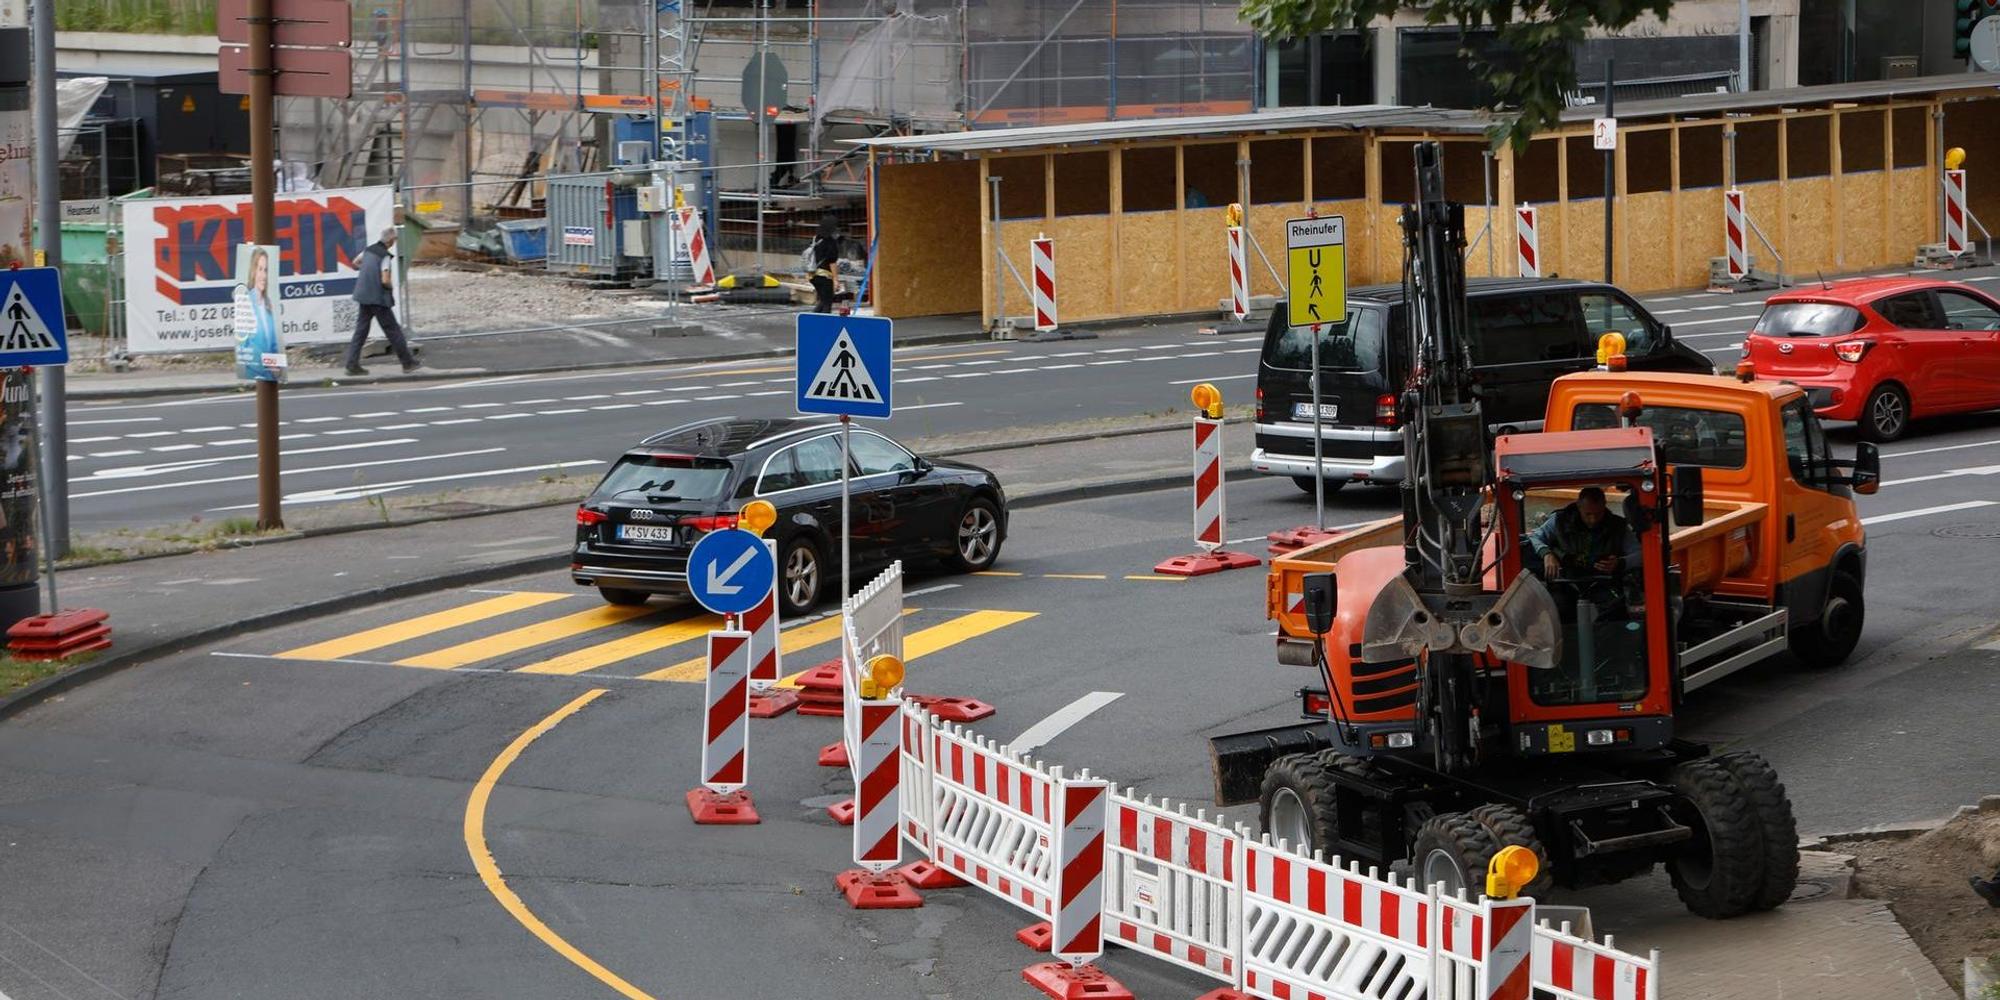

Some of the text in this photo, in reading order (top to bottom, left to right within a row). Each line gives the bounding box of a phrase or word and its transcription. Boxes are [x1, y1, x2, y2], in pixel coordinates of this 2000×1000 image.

[66, 203, 100, 216] Heumarkt
[1292, 223, 1337, 236] Rheinufer
[177, 208, 367, 282] KLEIN
[1309, 249, 1320, 268] U
[284, 282, 325, 299] Co.KG
[156, 309, 185, 323] Tel.:
[189, 308, 197, 321] 0
[202, 307, 219, 320] 22
[624, 526, 668, 540] K SV 433
